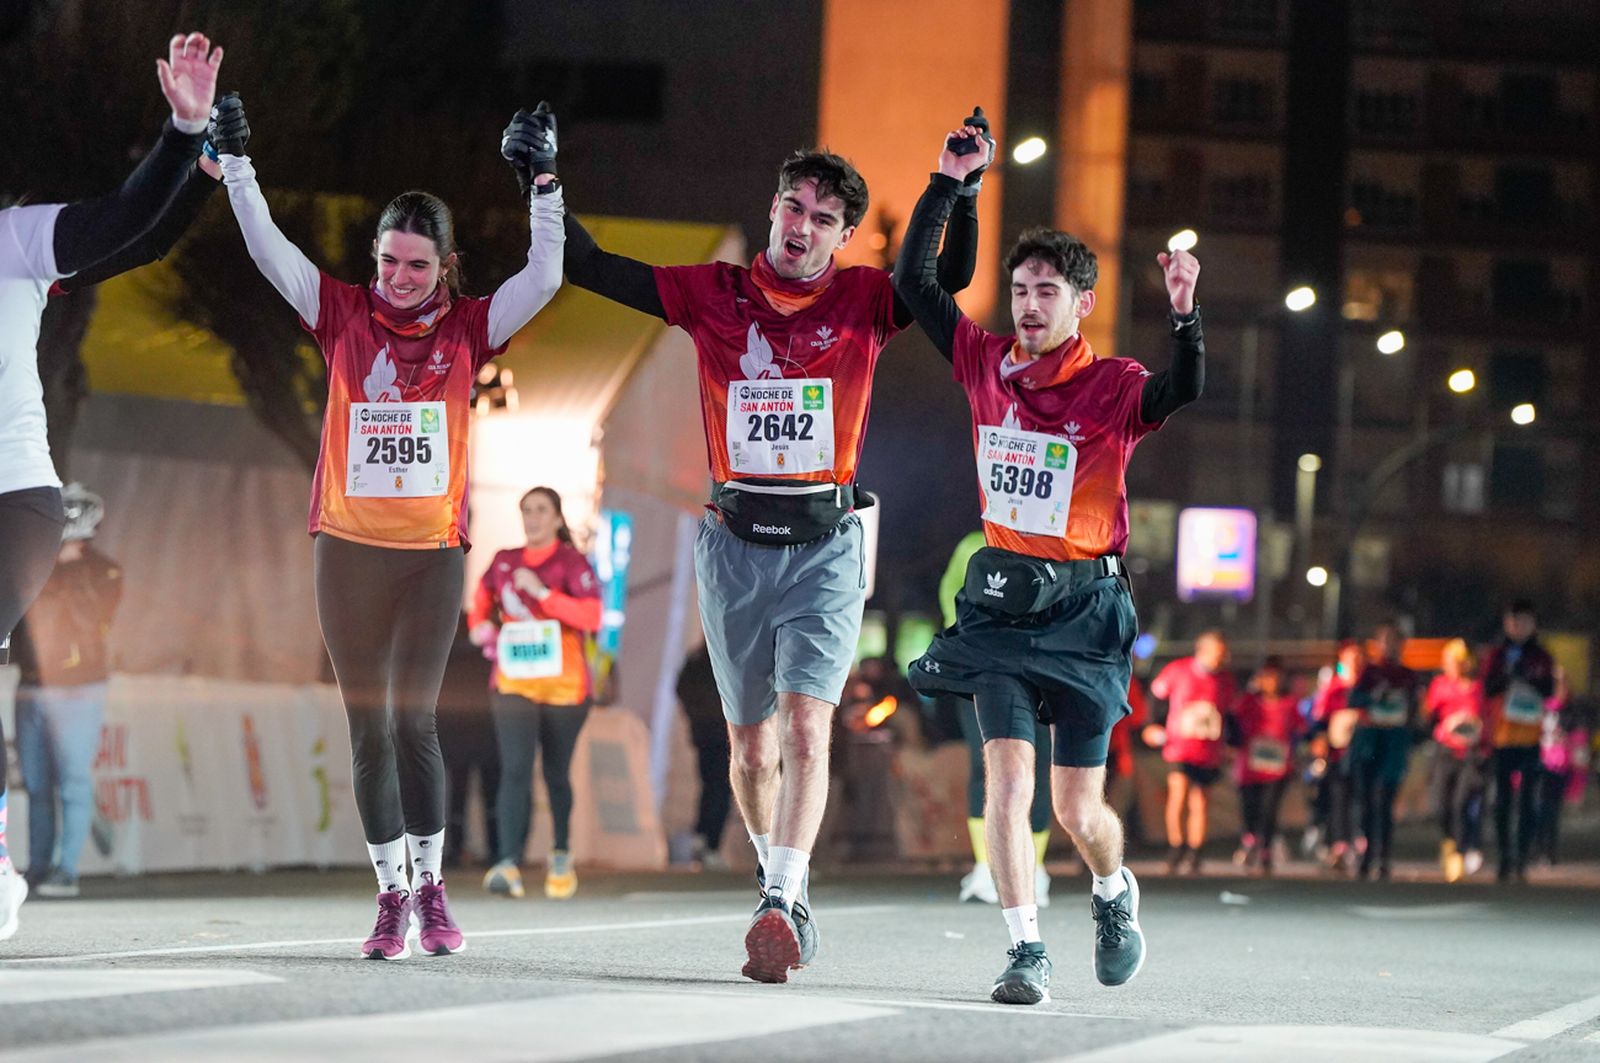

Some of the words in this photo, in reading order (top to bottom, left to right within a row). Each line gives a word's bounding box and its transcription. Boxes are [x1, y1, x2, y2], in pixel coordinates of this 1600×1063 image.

[750, 390, 779, 399] NOCHE
[781, 389, 793, 399] DE
[740, 402, 758, 412] SAN
[760, 399, 793, 412] ANTÓN
[371, 413, 398, 422] NOCHE
[400, 413, 412, 422] DE
[360, 425, 378, 435] SAN
[380, 422, 412, 435] ANTÓN
[747, 413, 814, 442] 2642
[366, 436, 432, 465] 2595
[998, 439, 1025, 452] NOCHE
[1025, 443, 1037, 453] DE
[987, 449, 1003, 460] SAN
[1004, 451, 1035, 466] ANTÓN
[990, 463, 1054, 499] 5398
[752, 523, 792, 535] Reebok
[983, 588, 1004, 598] adidas
